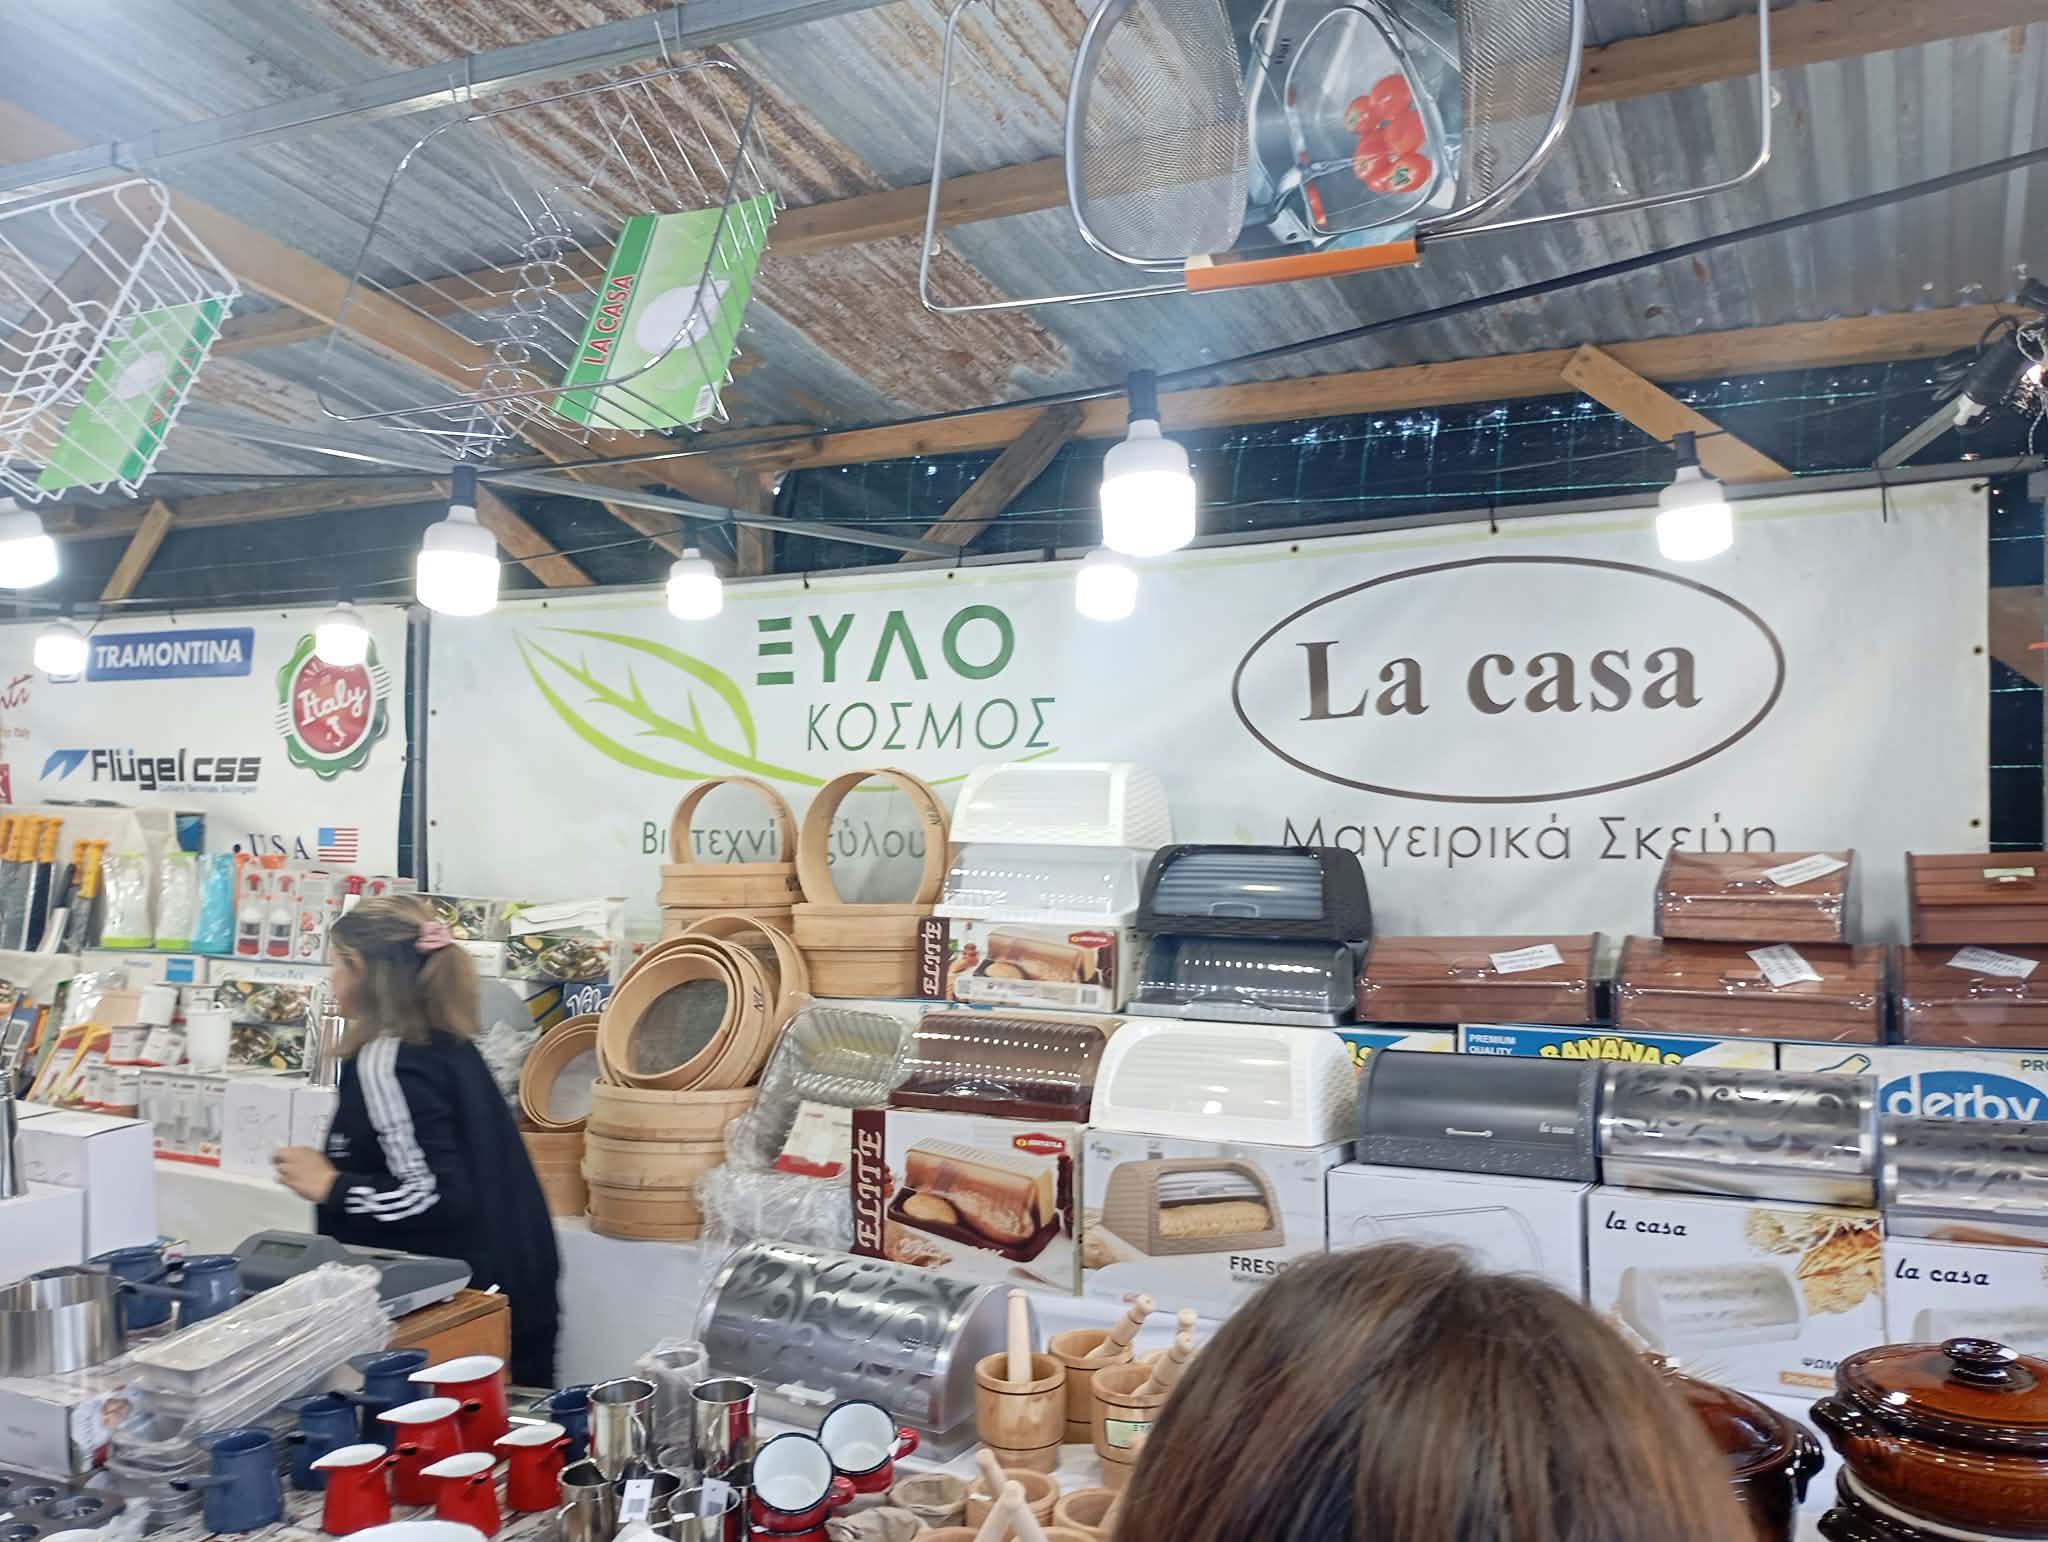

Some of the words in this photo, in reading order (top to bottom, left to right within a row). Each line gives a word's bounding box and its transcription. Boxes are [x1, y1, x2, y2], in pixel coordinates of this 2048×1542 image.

[596, 274, 635, 332] CASA
[583, 338, 612, 364] LA
[95, 638, 243, 669] TRAMONTINA
[757, 604, 1015, 686] ΞΥΛΟ
[296, 678, 369, 727] Italy
[1296, 640, 1430, 721] La
[1467, 646, 1704, 715] casa
[807, 697, 1056, 752] ΚΟΣΜΟΣ
[91, 747, 187, 791] Flügel
[193, 757, 262, 782] css
[642, 818, 785, 864] Βιτεχνί
[1282, 813, 1571, 867] Μαγειρικά
[918, 921, 942, 996] ELITE
[1469, 1033, 1517, 1045] PREMIUM
[1469, 1045, 1513, 1056] QUALITY
[853, 1129, 883, 1250] ELITE
[1636, 1221, 1688, 1236] casa
[1930, 1269, 1990, 1286] casa
